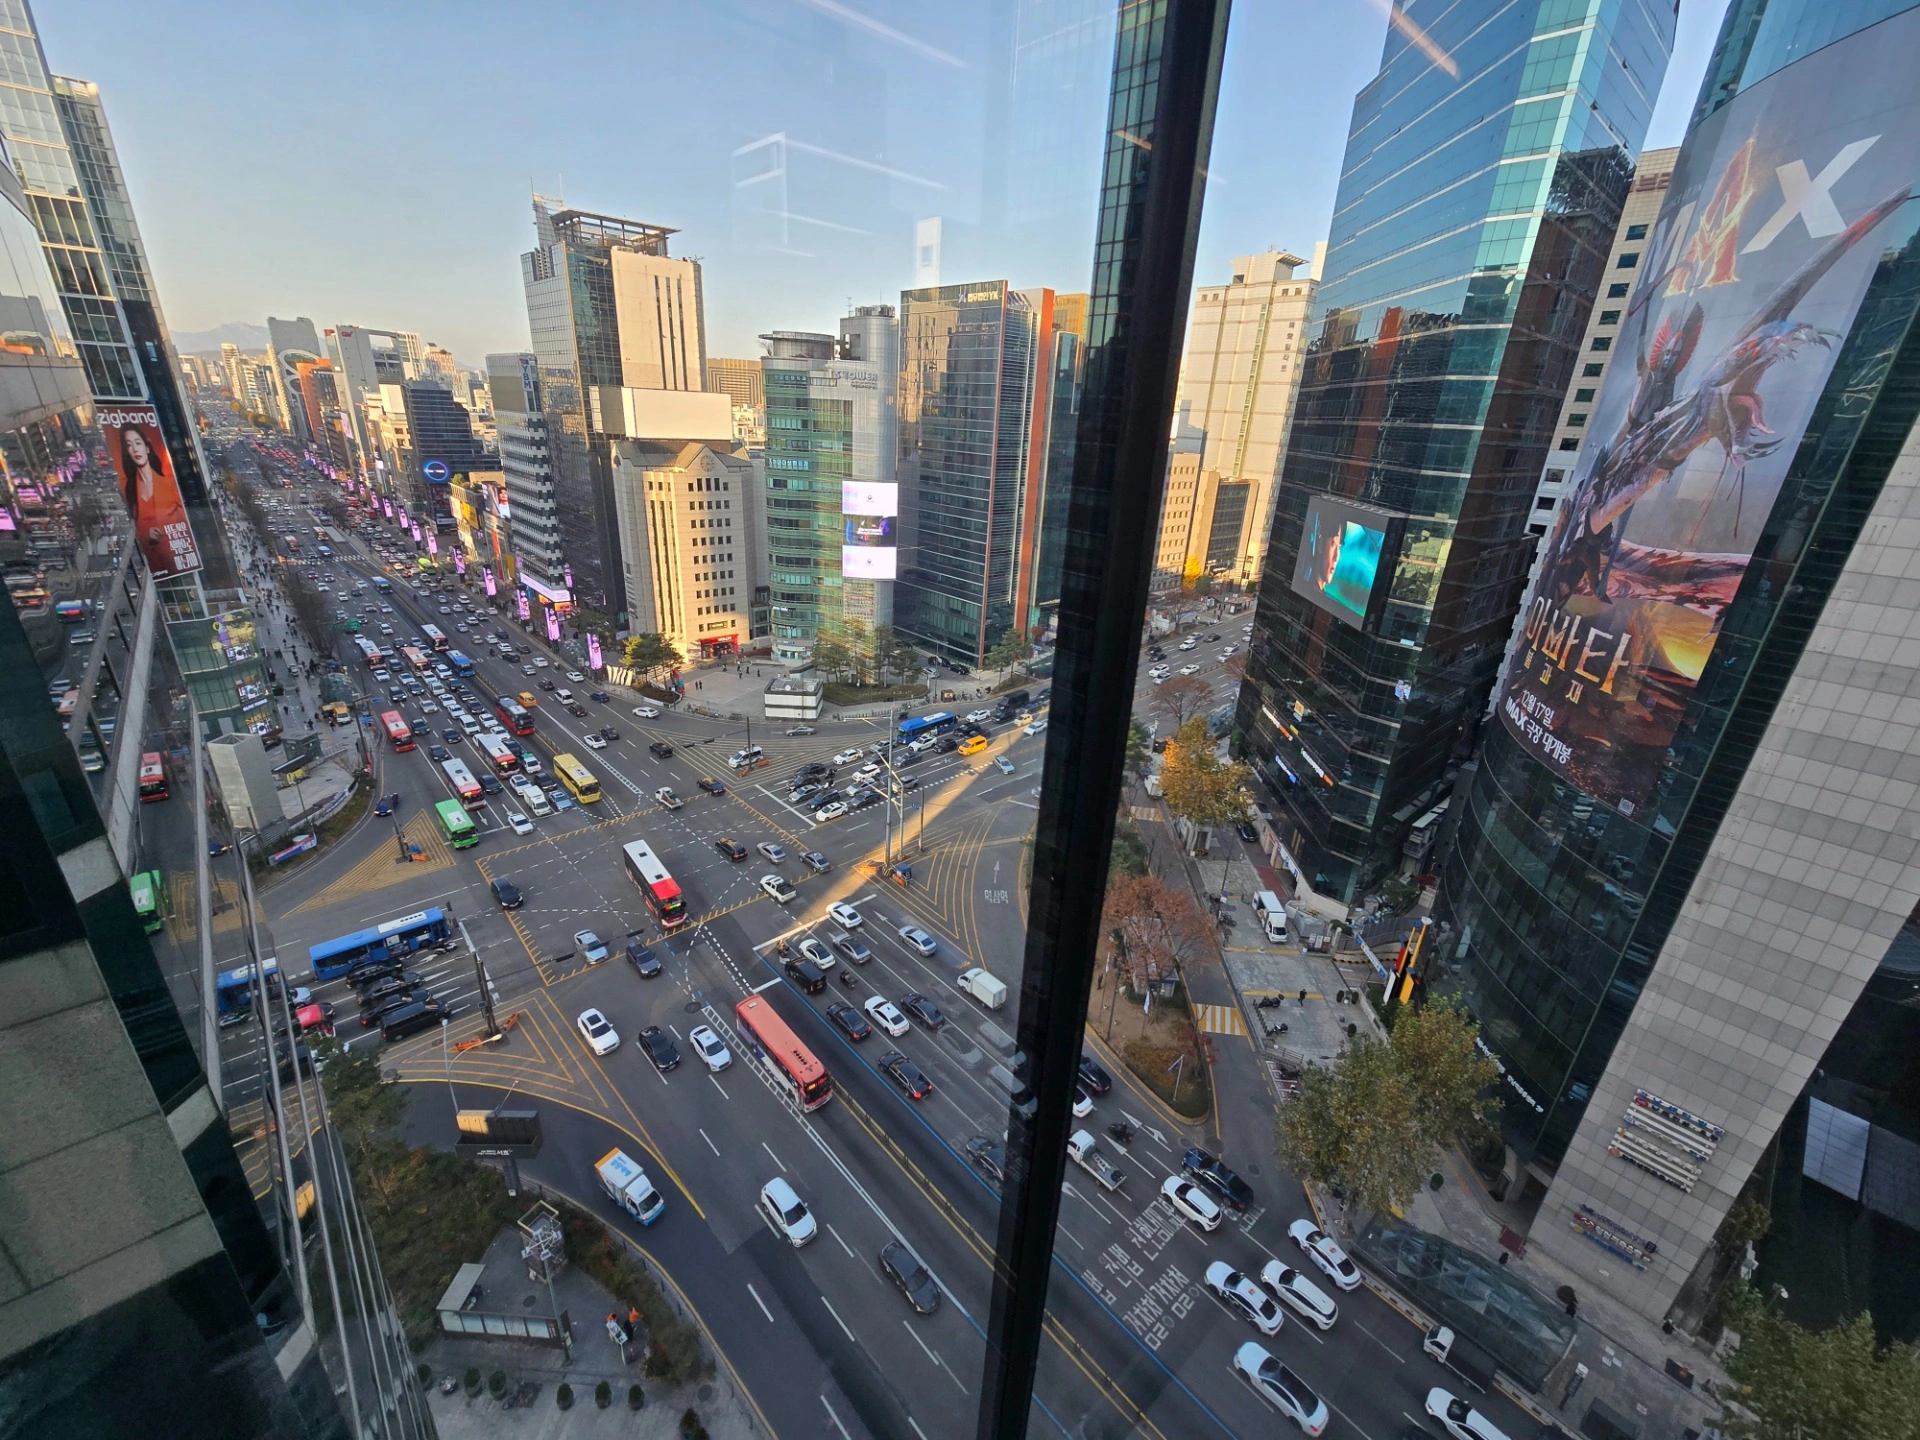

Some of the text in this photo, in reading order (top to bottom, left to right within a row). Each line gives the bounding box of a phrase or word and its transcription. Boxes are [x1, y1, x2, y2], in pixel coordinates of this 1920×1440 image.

[521, 364, 532, 390] YBM
[96, 409, 158, 429] zigbang
[1526, 596, 1632, 695] 아바타
[1505, 695, 1573, 764] IMAX 극장 대개봉
[1521, 689, 1555, 729] 12월 17일
[1149, 1264, 1200, 1319] 검찰청
[1122, 1293, 1175, 1351] 검찰청
